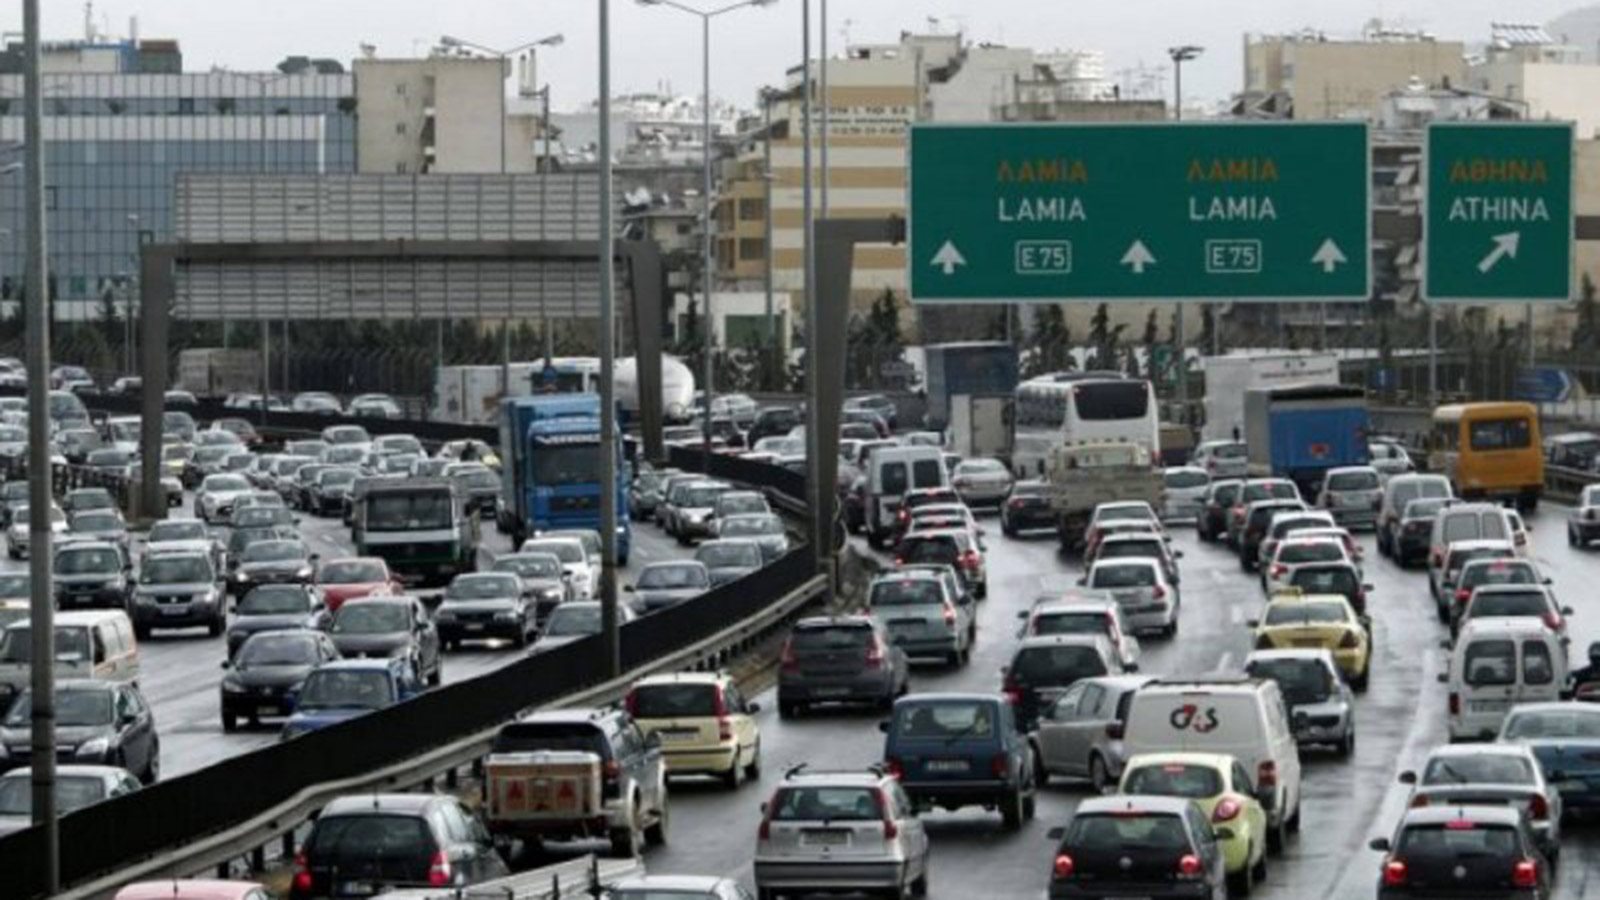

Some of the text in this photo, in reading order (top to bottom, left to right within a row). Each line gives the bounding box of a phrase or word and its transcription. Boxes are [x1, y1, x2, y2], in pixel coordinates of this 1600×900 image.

[1449, 157, 1548, 184] ΑΘΗΝΑ
[998, 196, 1087, 222] LAMIA
[1189, 195, 1277, 221] LAMIA
[1448, 196, 1550, 222] ATHINA
